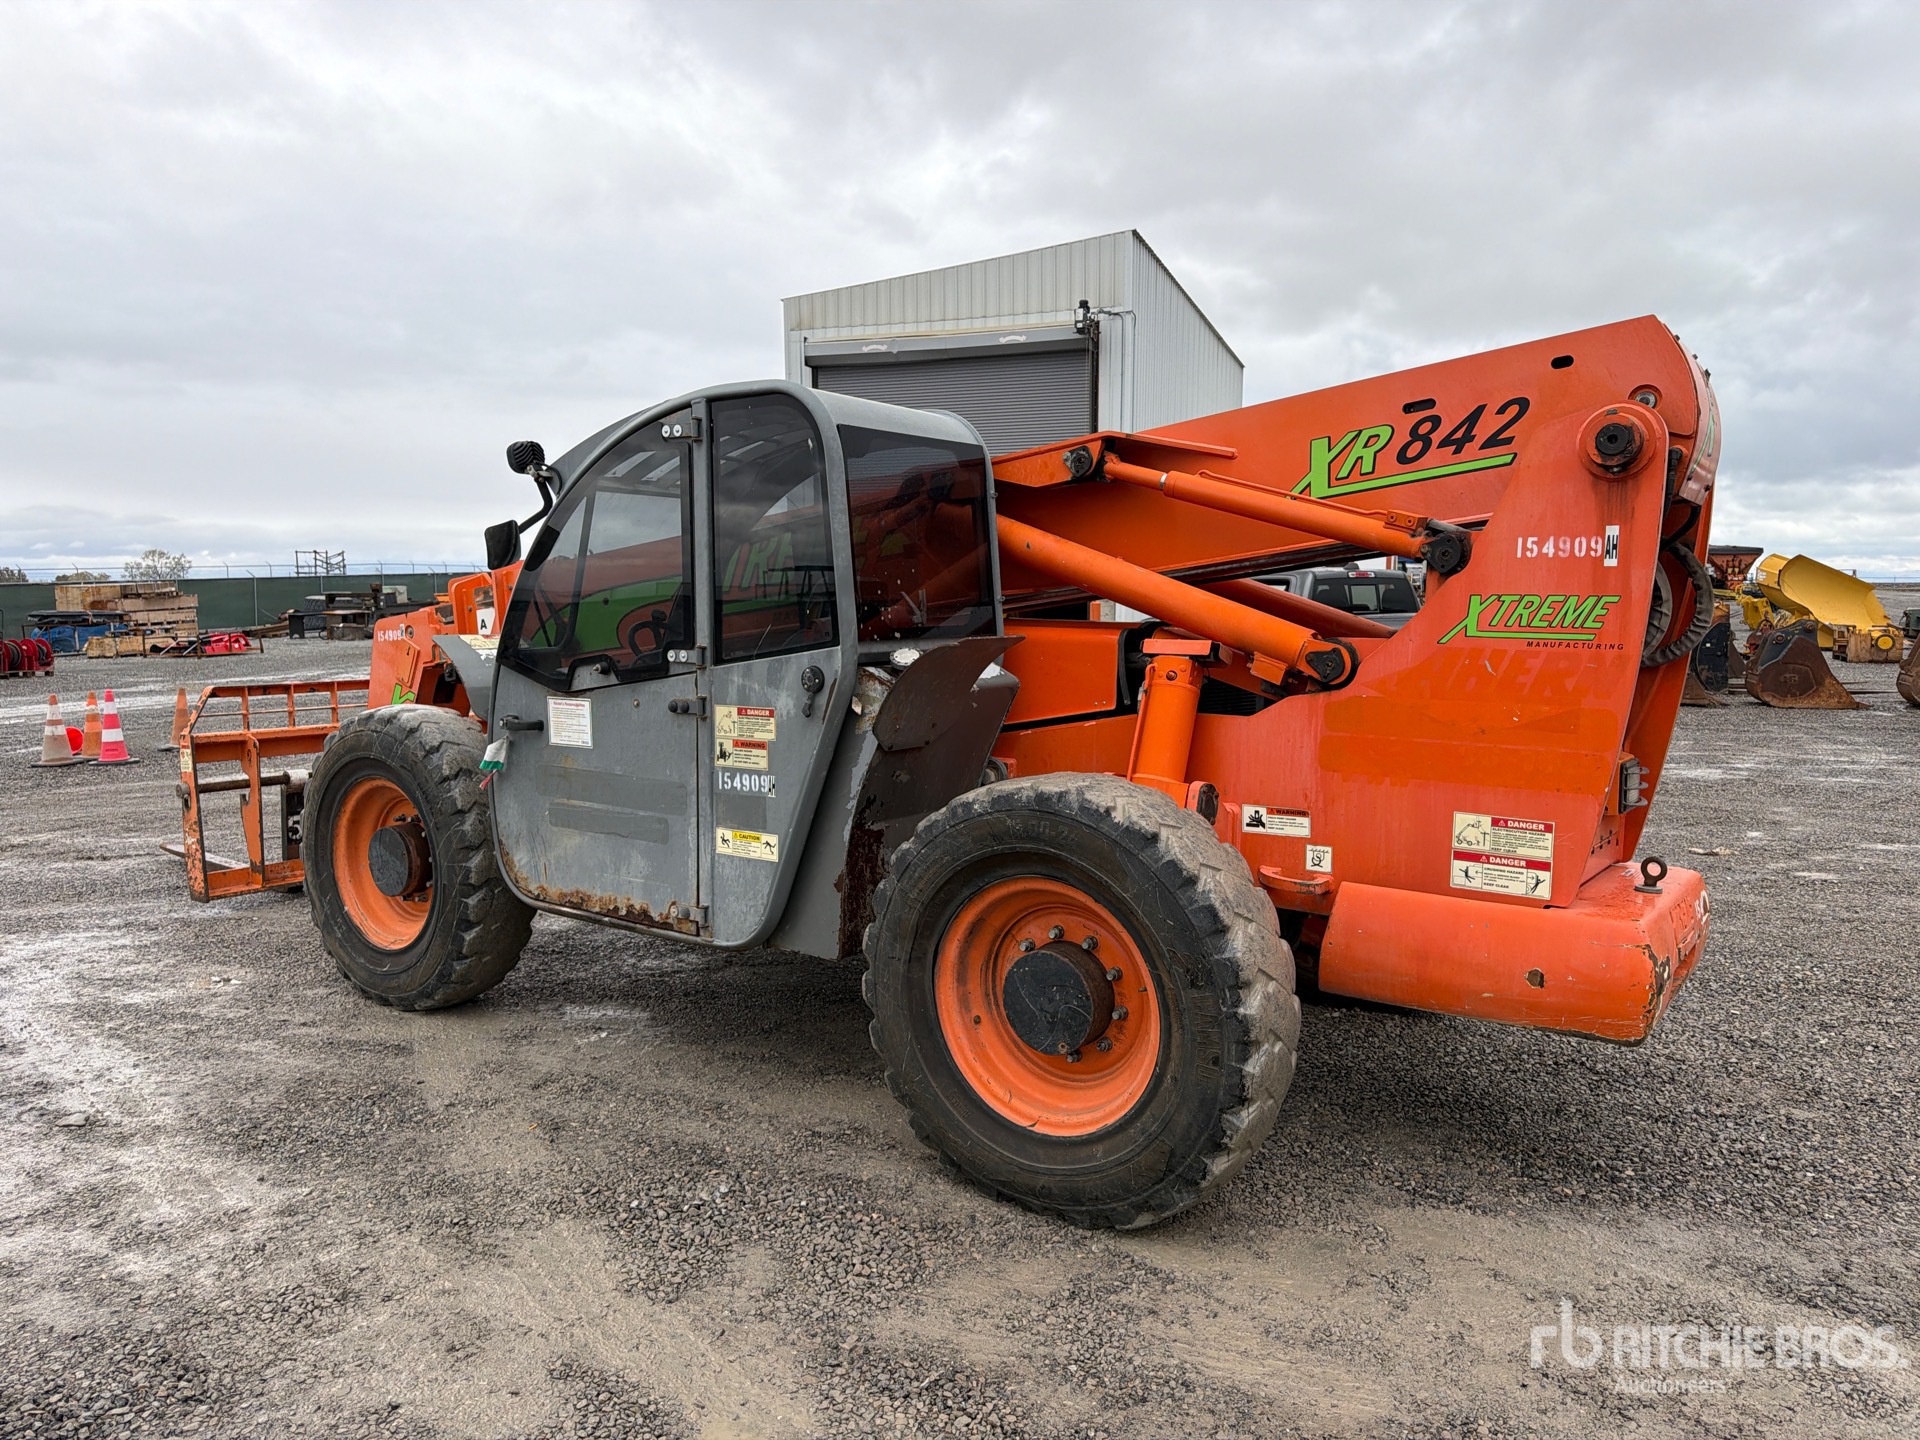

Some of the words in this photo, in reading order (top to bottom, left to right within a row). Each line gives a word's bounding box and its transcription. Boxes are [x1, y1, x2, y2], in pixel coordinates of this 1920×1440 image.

[1286, 423, 1394, 499] XR
[1396, 396, 1531, 465] 842
[1516, 535, 1603, 558] 154909
[1604, 534, 1619, 560] AH
[1437, 594, 1622, 644] XTREME
[1526, 641, 1625, 651] MANUFACTURING
[740, 741, 765, 749] WARNING
[718, 771, 768, 793] 154909
[1275, 808, 1307, 816] WARNING
[1507, 820, 1545, 831] DANGER
[738, 833, 760, 841] CAUTION
[1489, 856, 1527, 867] DANGER
